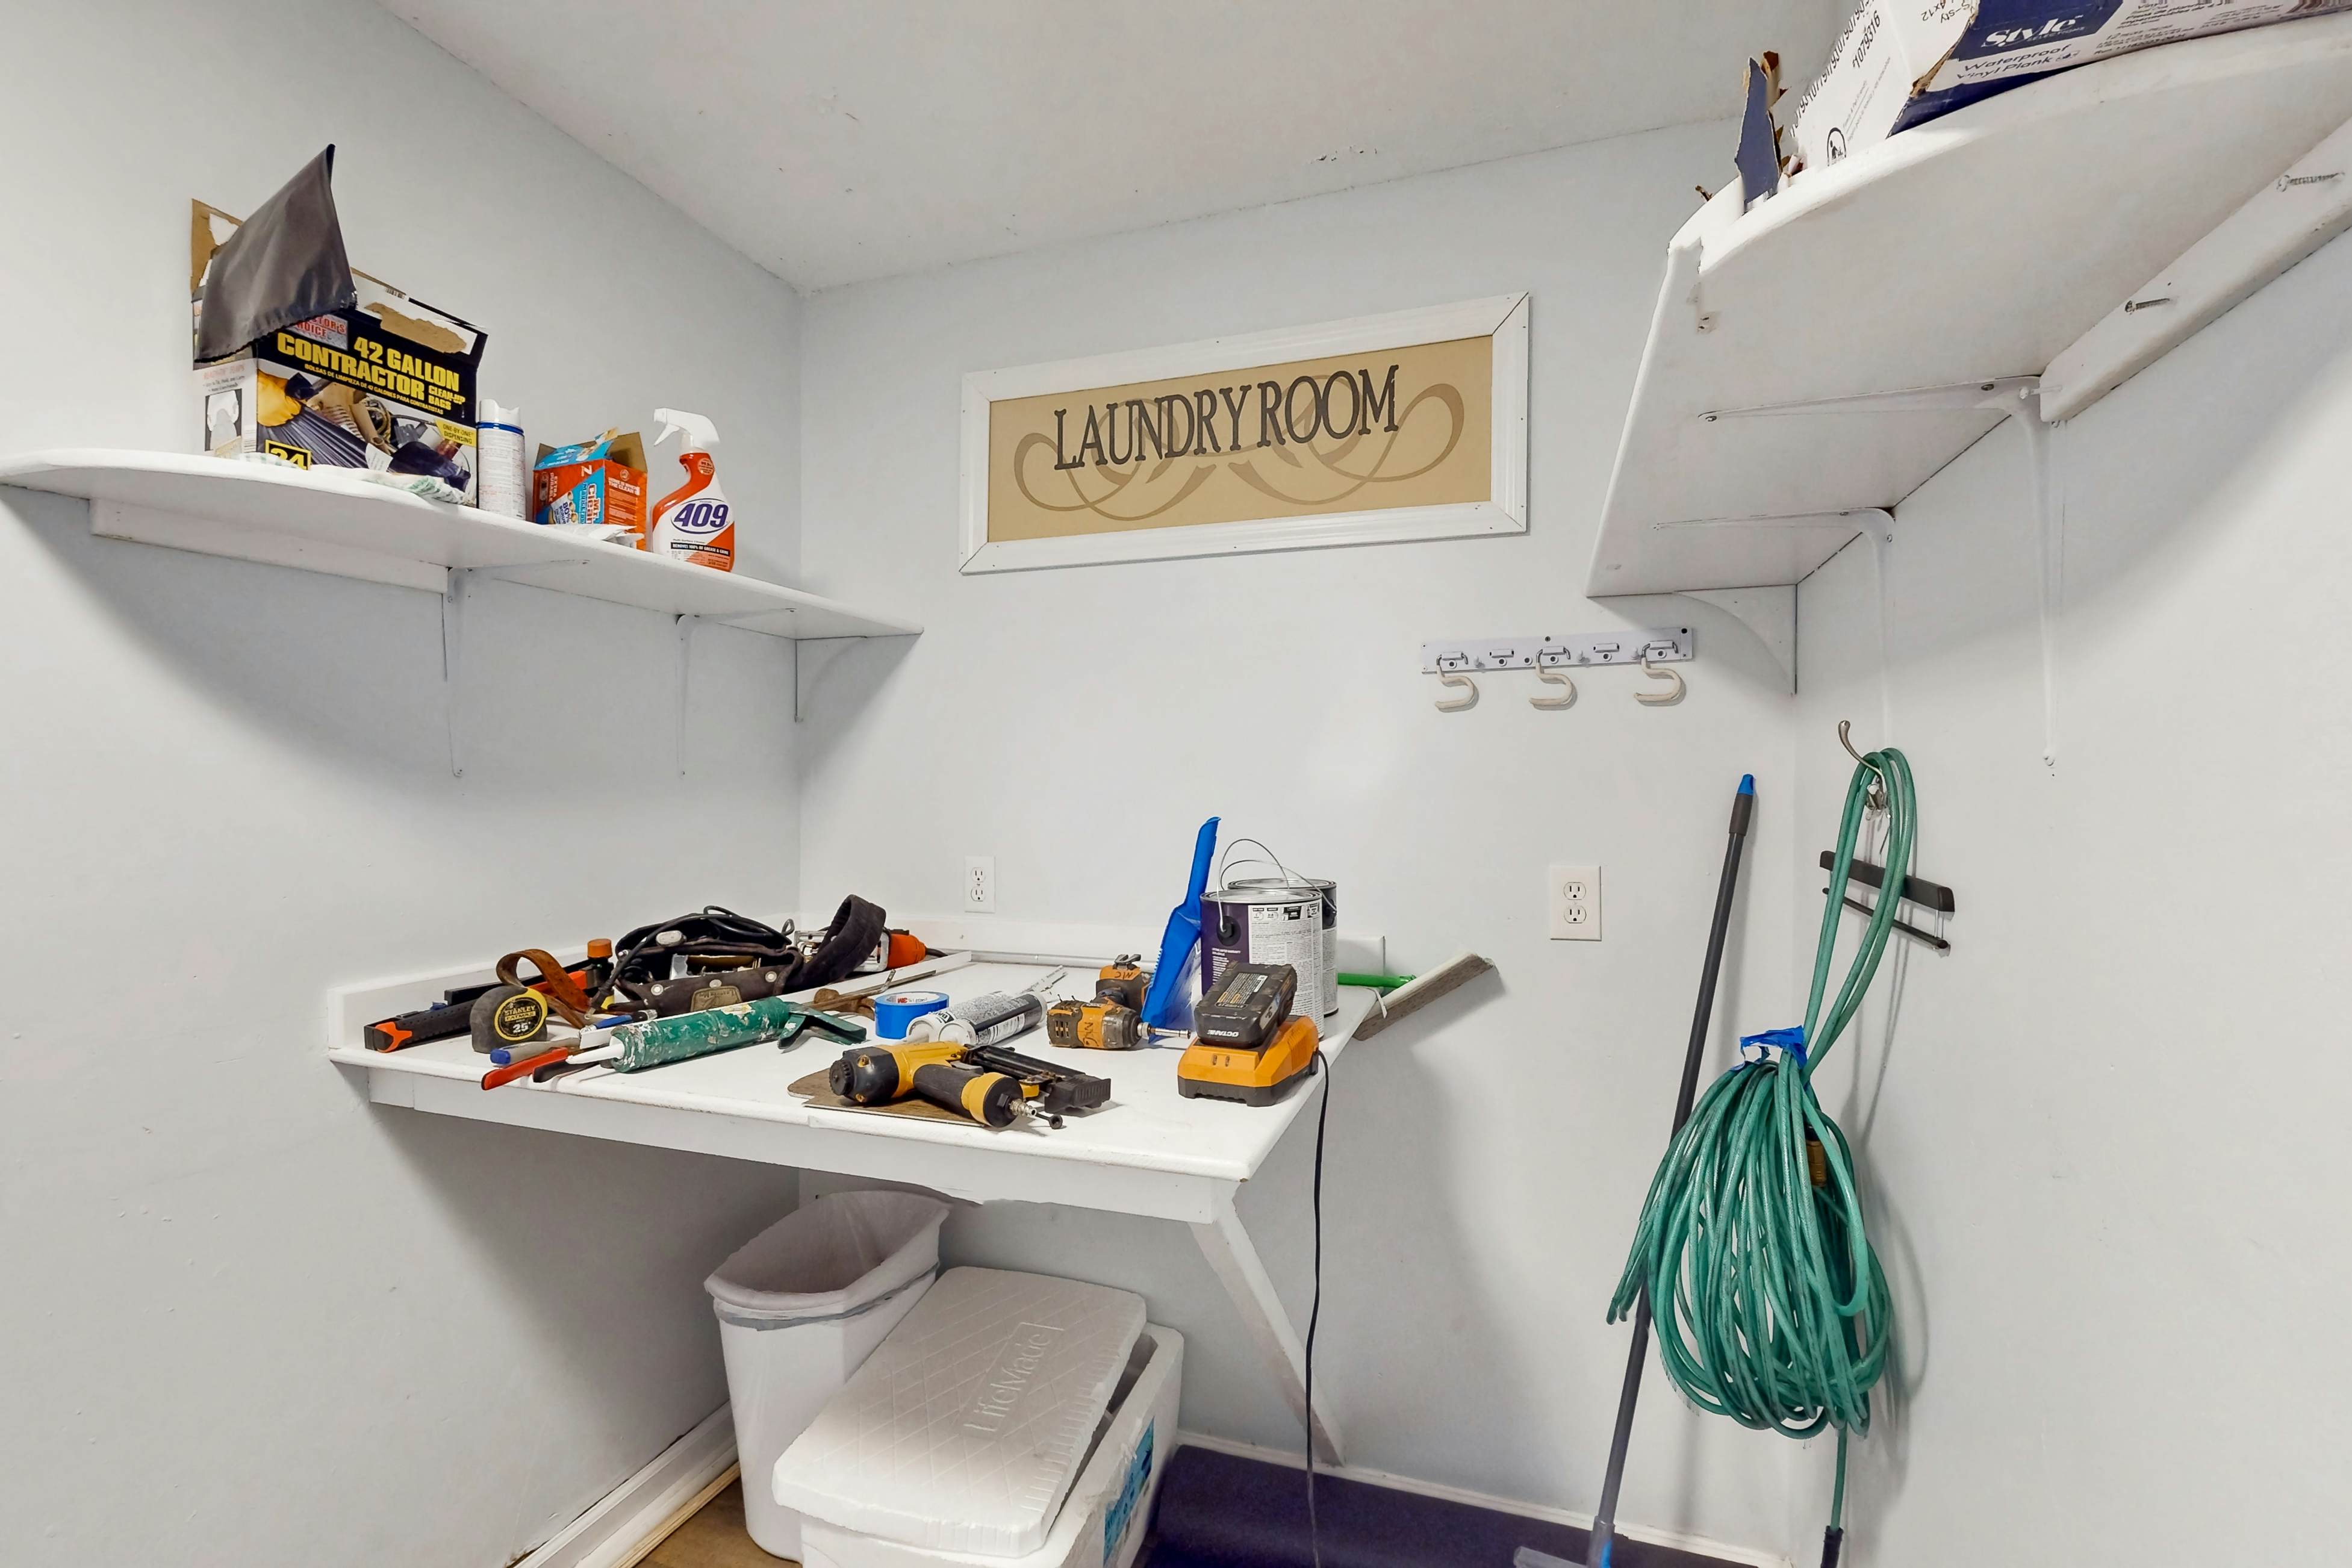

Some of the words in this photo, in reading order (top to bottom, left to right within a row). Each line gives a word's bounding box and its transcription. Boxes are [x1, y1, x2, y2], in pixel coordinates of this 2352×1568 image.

[1981, 18, 2077, 48] Style
[1965, 43, 2072, 72] Waterproof
[2003, 56, 2052, 73] Plank
[277, 332, 425, 401] CONTRACTOR
[353, 336, 384, 365] 42
[387, 347, 459, 392] GALLON
[304, 363, 326, 376] BOLSAS
[335, 373, 360, 386] LIMPIEZA
[396, 394, 409, 403] PARA
[409, 399, 444, 415] CONTRATISTAS
[428, 385, 466, 405] CLEAN-UP
[428, 394, 452, 411] BAGS
[1054, 382, 1252, 471] LAUNDRY
[1257, 364, 1400, 449] ROOM
[673, 503, 729, 528] 409
[505, 1005, 536, 1016] STANLEY
[506, 1012, 535, 1021] FATMAX
[1207, 1029, 1239, 1038] OCTANE
